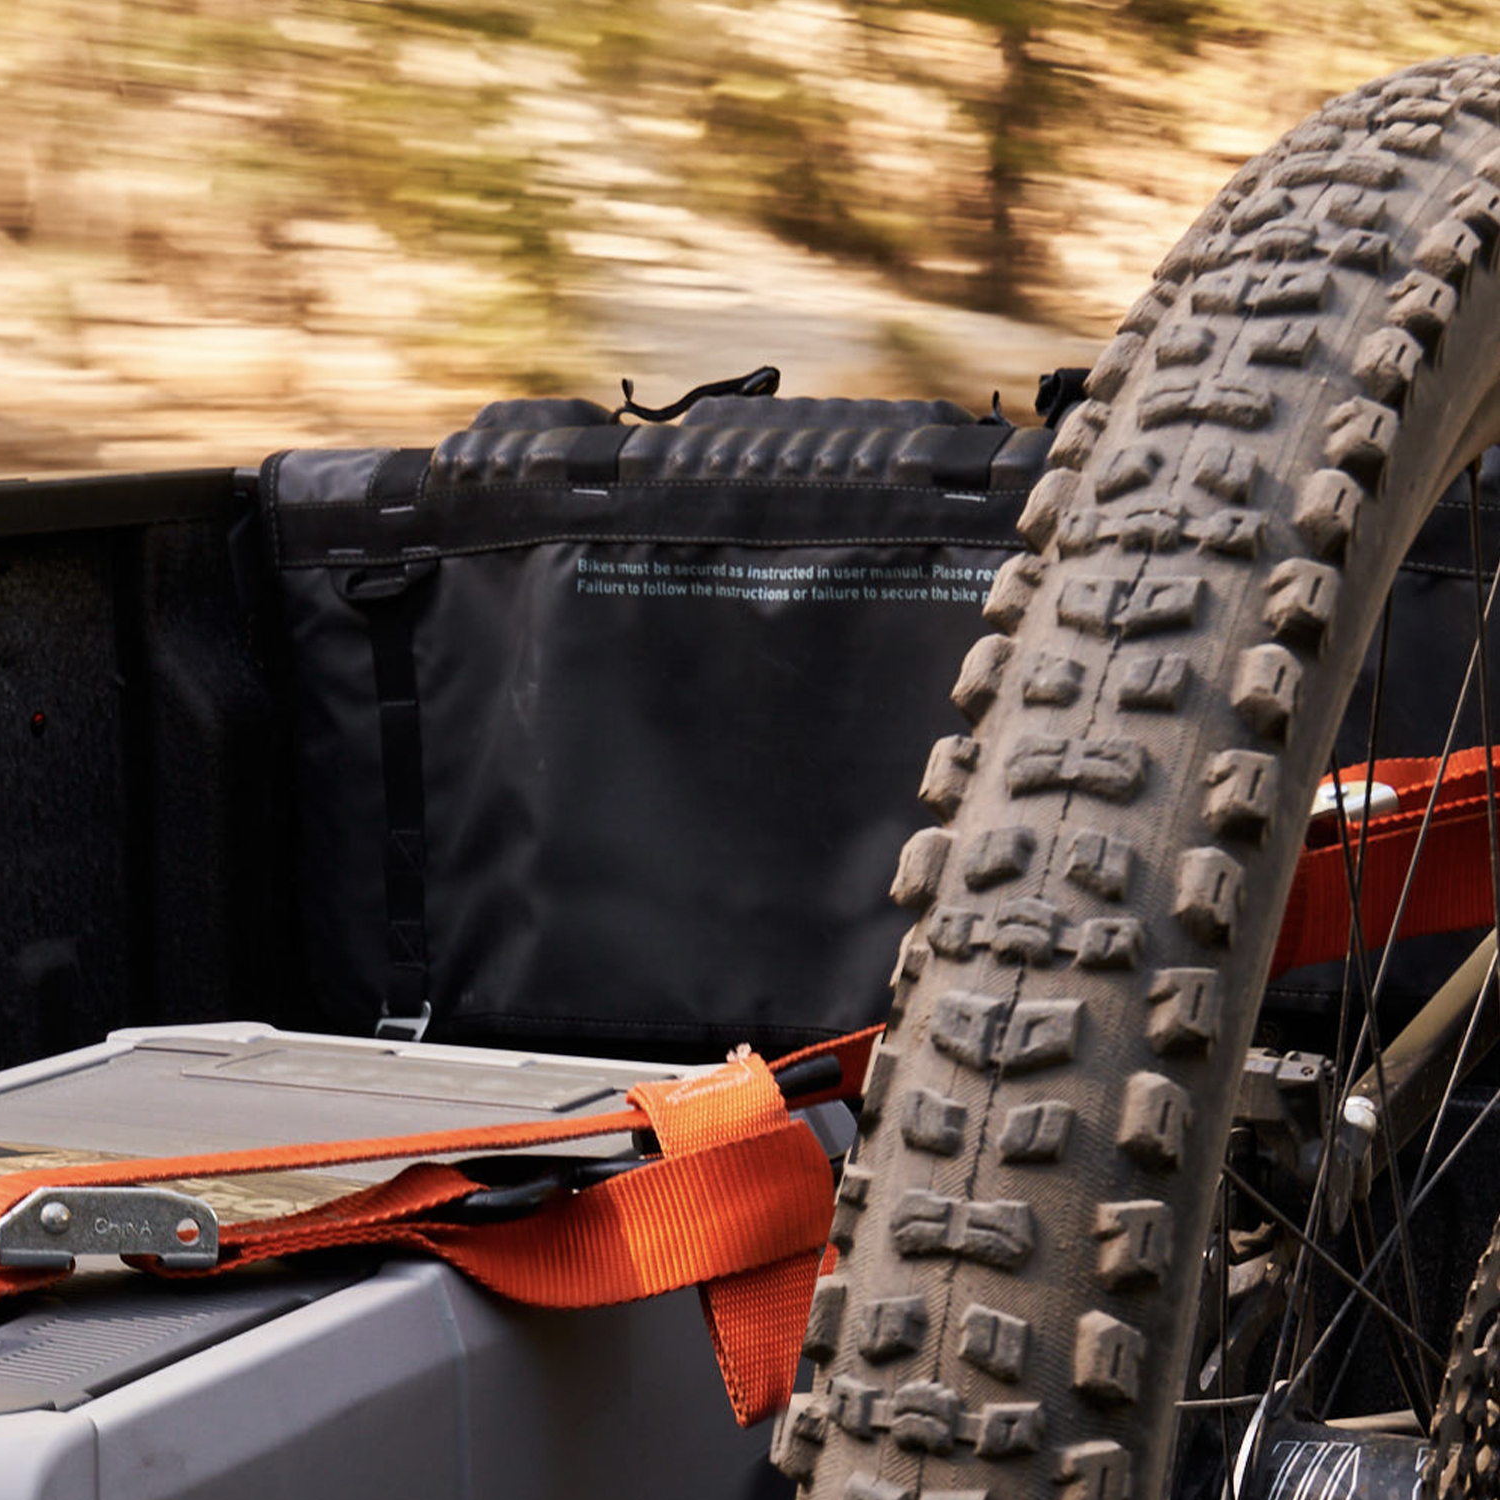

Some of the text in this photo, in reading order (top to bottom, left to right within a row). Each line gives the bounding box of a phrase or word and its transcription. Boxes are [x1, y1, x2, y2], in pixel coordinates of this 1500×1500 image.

[577, 559, 616, 574] Bikes
[618, 562, 649, 575] must
[654, 561, 670, 575] be
[674, 563, 726, 577] secured
[728, 565, 743, 578] as
[747, 564, 814, 580] instructed
[817, 565, 829, 580] in
[834, 567, 865, 580] user
[931, 565, 972, 581] Please
[577, 579, 624, 594] Failure
[627, 582, 640, 595] to
[643, 580, 687, 596] follow
[691, 582, 713, 596] the
[716, 584, 790, 601] instructions
[793, 588, 807, 601] or
[811, 585, 859, 600] failure
[863, 587, 877, 600] to
[881, 588, 927, 601] secure
[931, 586, 949, 601] the
[952, 587, 977, 603] bike
